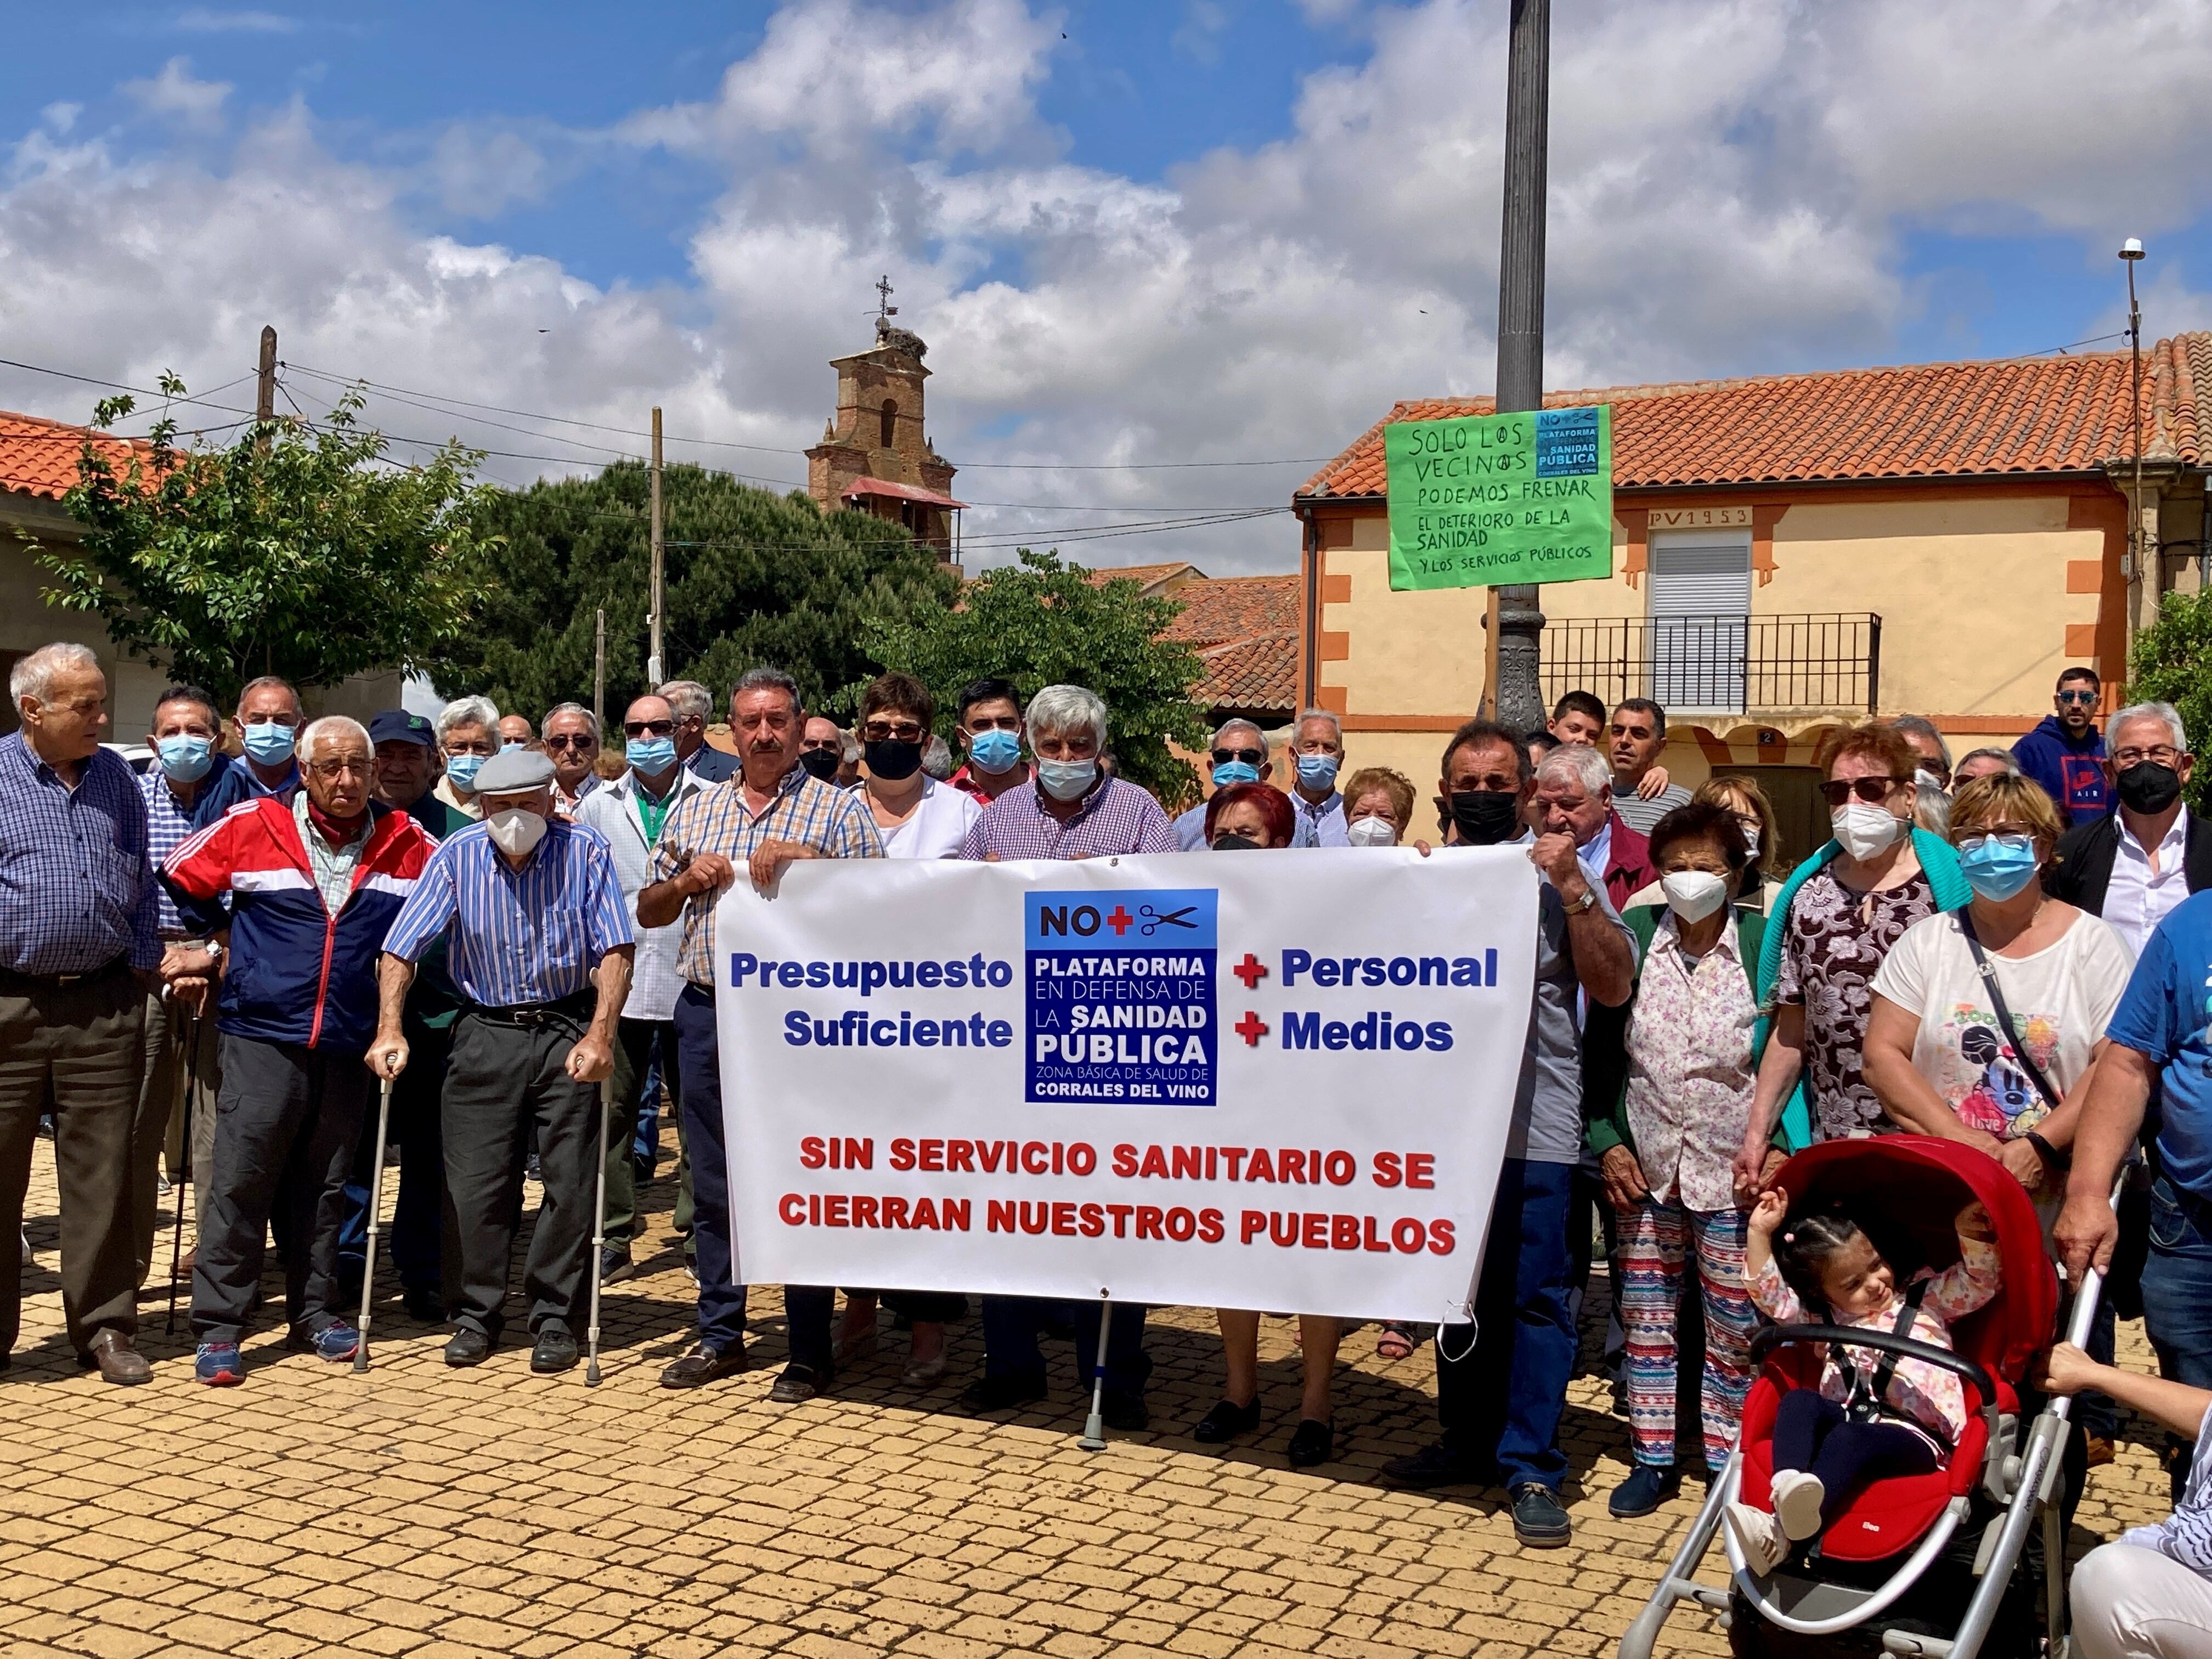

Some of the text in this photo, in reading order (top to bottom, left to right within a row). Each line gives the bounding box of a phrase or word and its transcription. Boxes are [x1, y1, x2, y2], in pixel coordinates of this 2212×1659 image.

[1408, 427, 1466, 455] SOLO
[1538, 428, 1595, 439] PLATAFORMA
[1538, 453, 1596, 466] PÚBLICA
[1550, 444, 1596, 454] SANIDAD
[1418, 479, 1596, 506] PODEMOS FRENAR
[1418, 509, 1570, 531] EL DETERIORO DE LA
[1417, 531, 1488, 551] SANIDAD
[1462, 550, 1523, 569] SERVICIOS
[1530, 546, 1592, 562] PÚBLICOS
[1764, 732, 1771, 742] 2
[731, 952, 1013, 997] Presupuesto
[1035, 957, 1206, 977] PLATAFORMA
[1282, 948, 1498, 987] Personal
[1036, 980, 1205, 1000] EN DEFENSA DE
[783, 1010, 1013, 1047] Suficiente
[1036, 1005, 1207, 1029] LA SANIDAD
[1282, 1011, 1454, 1052] Medios
[1036, 1026, 1207, 1065] PÚBLICA
[1036, 1064, 1208, 1081] ZONA BÁSICA DE SALUD DE
[1035, 1082, 1209, 1099] CORRALES DEL VINO
[799, 1136, 1435, 1189] SIN SERVICIO SANITARIO SE
[778, 1193, 1455, 1256] CIERRAN NUESTROS PUEBLOS
